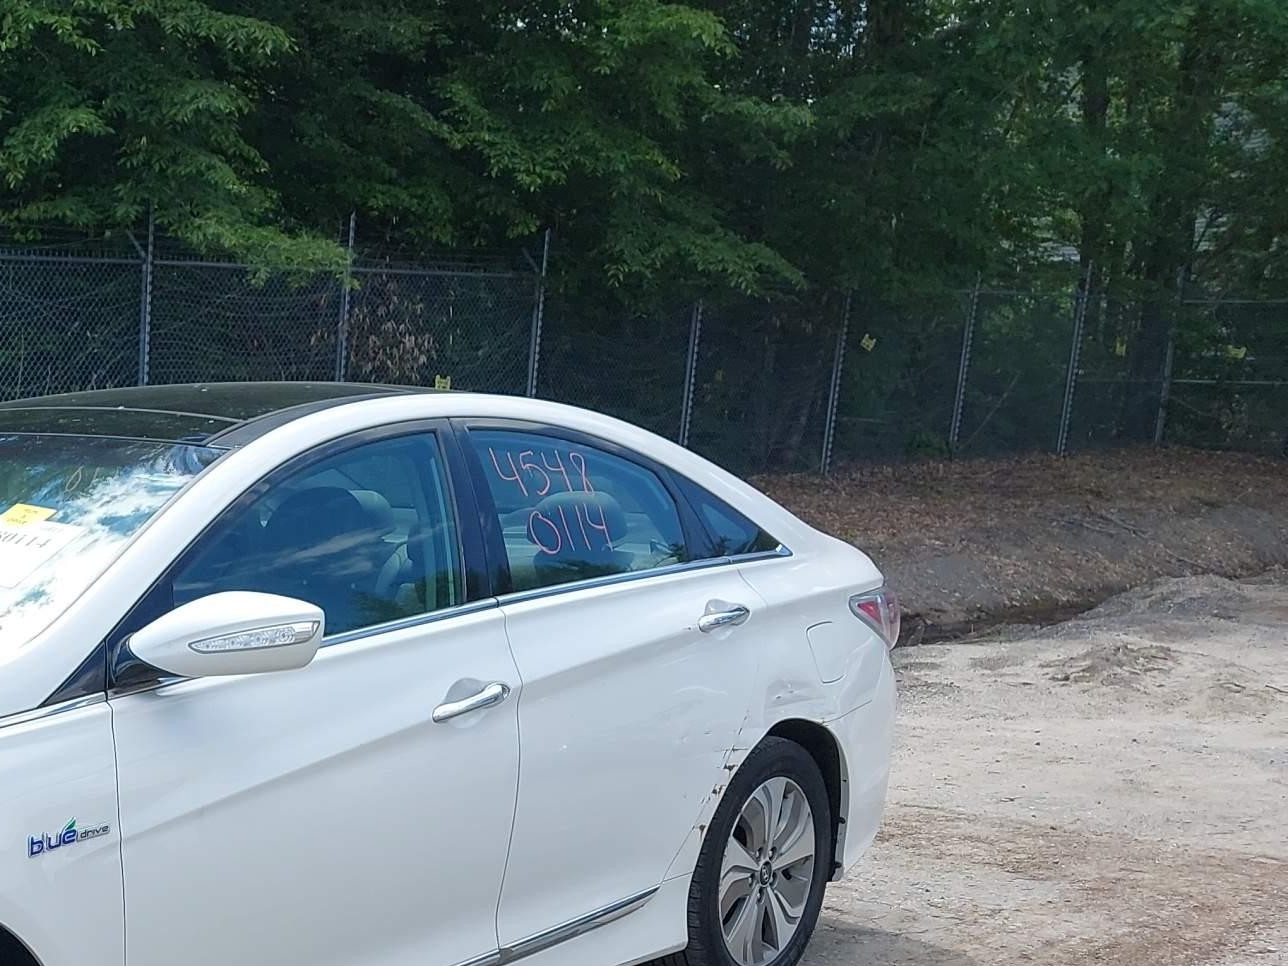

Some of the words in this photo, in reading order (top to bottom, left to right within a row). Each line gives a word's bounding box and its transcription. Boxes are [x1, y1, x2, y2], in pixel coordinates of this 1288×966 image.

[489, 447, 595, 497] 4548
[529, 503, 614, 555] 0114
[79, 823, 110, 840] drive
